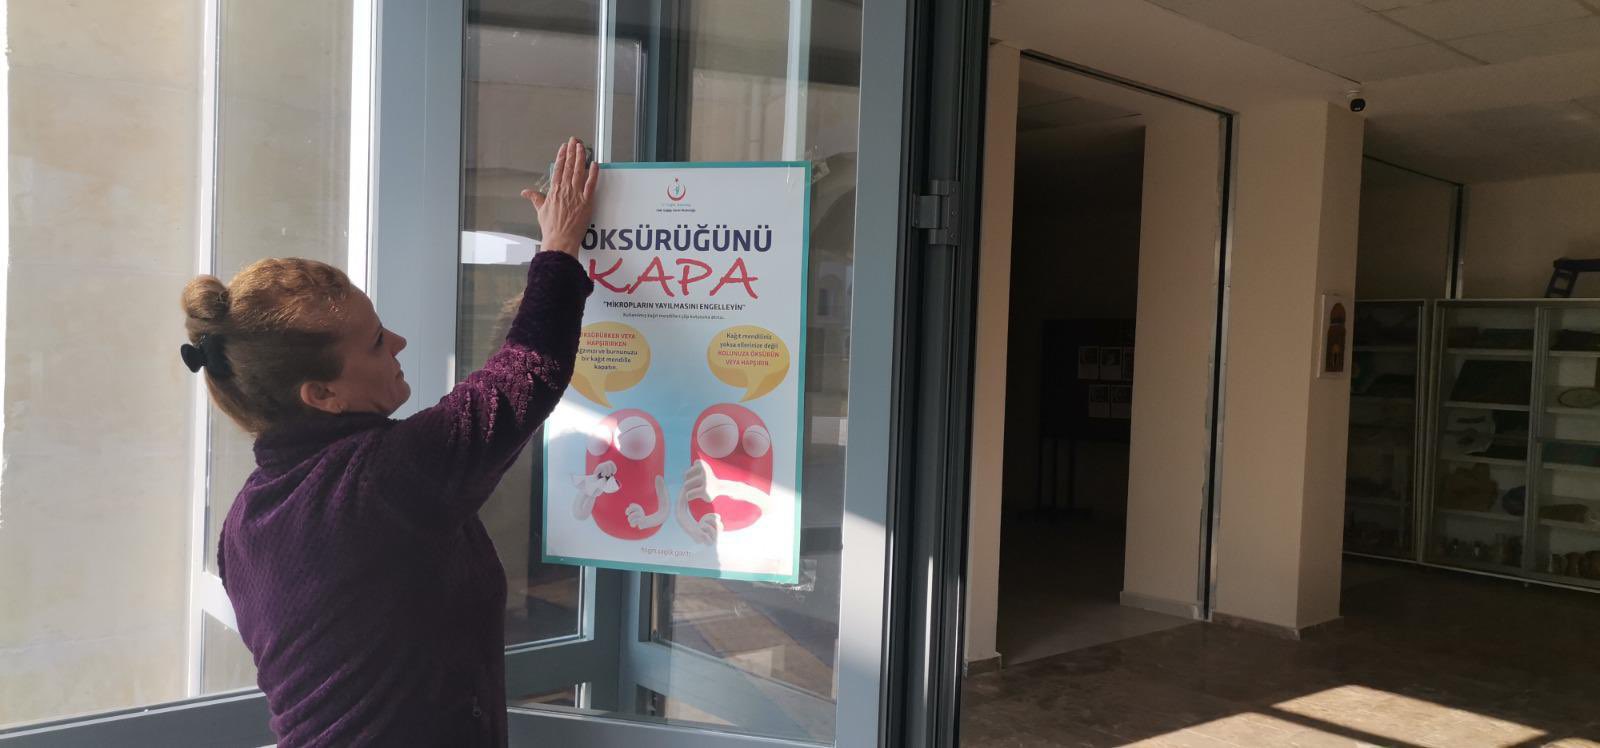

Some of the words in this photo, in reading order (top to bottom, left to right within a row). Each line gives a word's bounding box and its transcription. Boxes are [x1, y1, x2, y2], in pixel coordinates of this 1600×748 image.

[581, 224, 772, 252] ÖKSÜRÜĞÜNÜ
[588, 256, 758, 299] KAPA
[655, 302, 698, 310] YAYILMASINI
